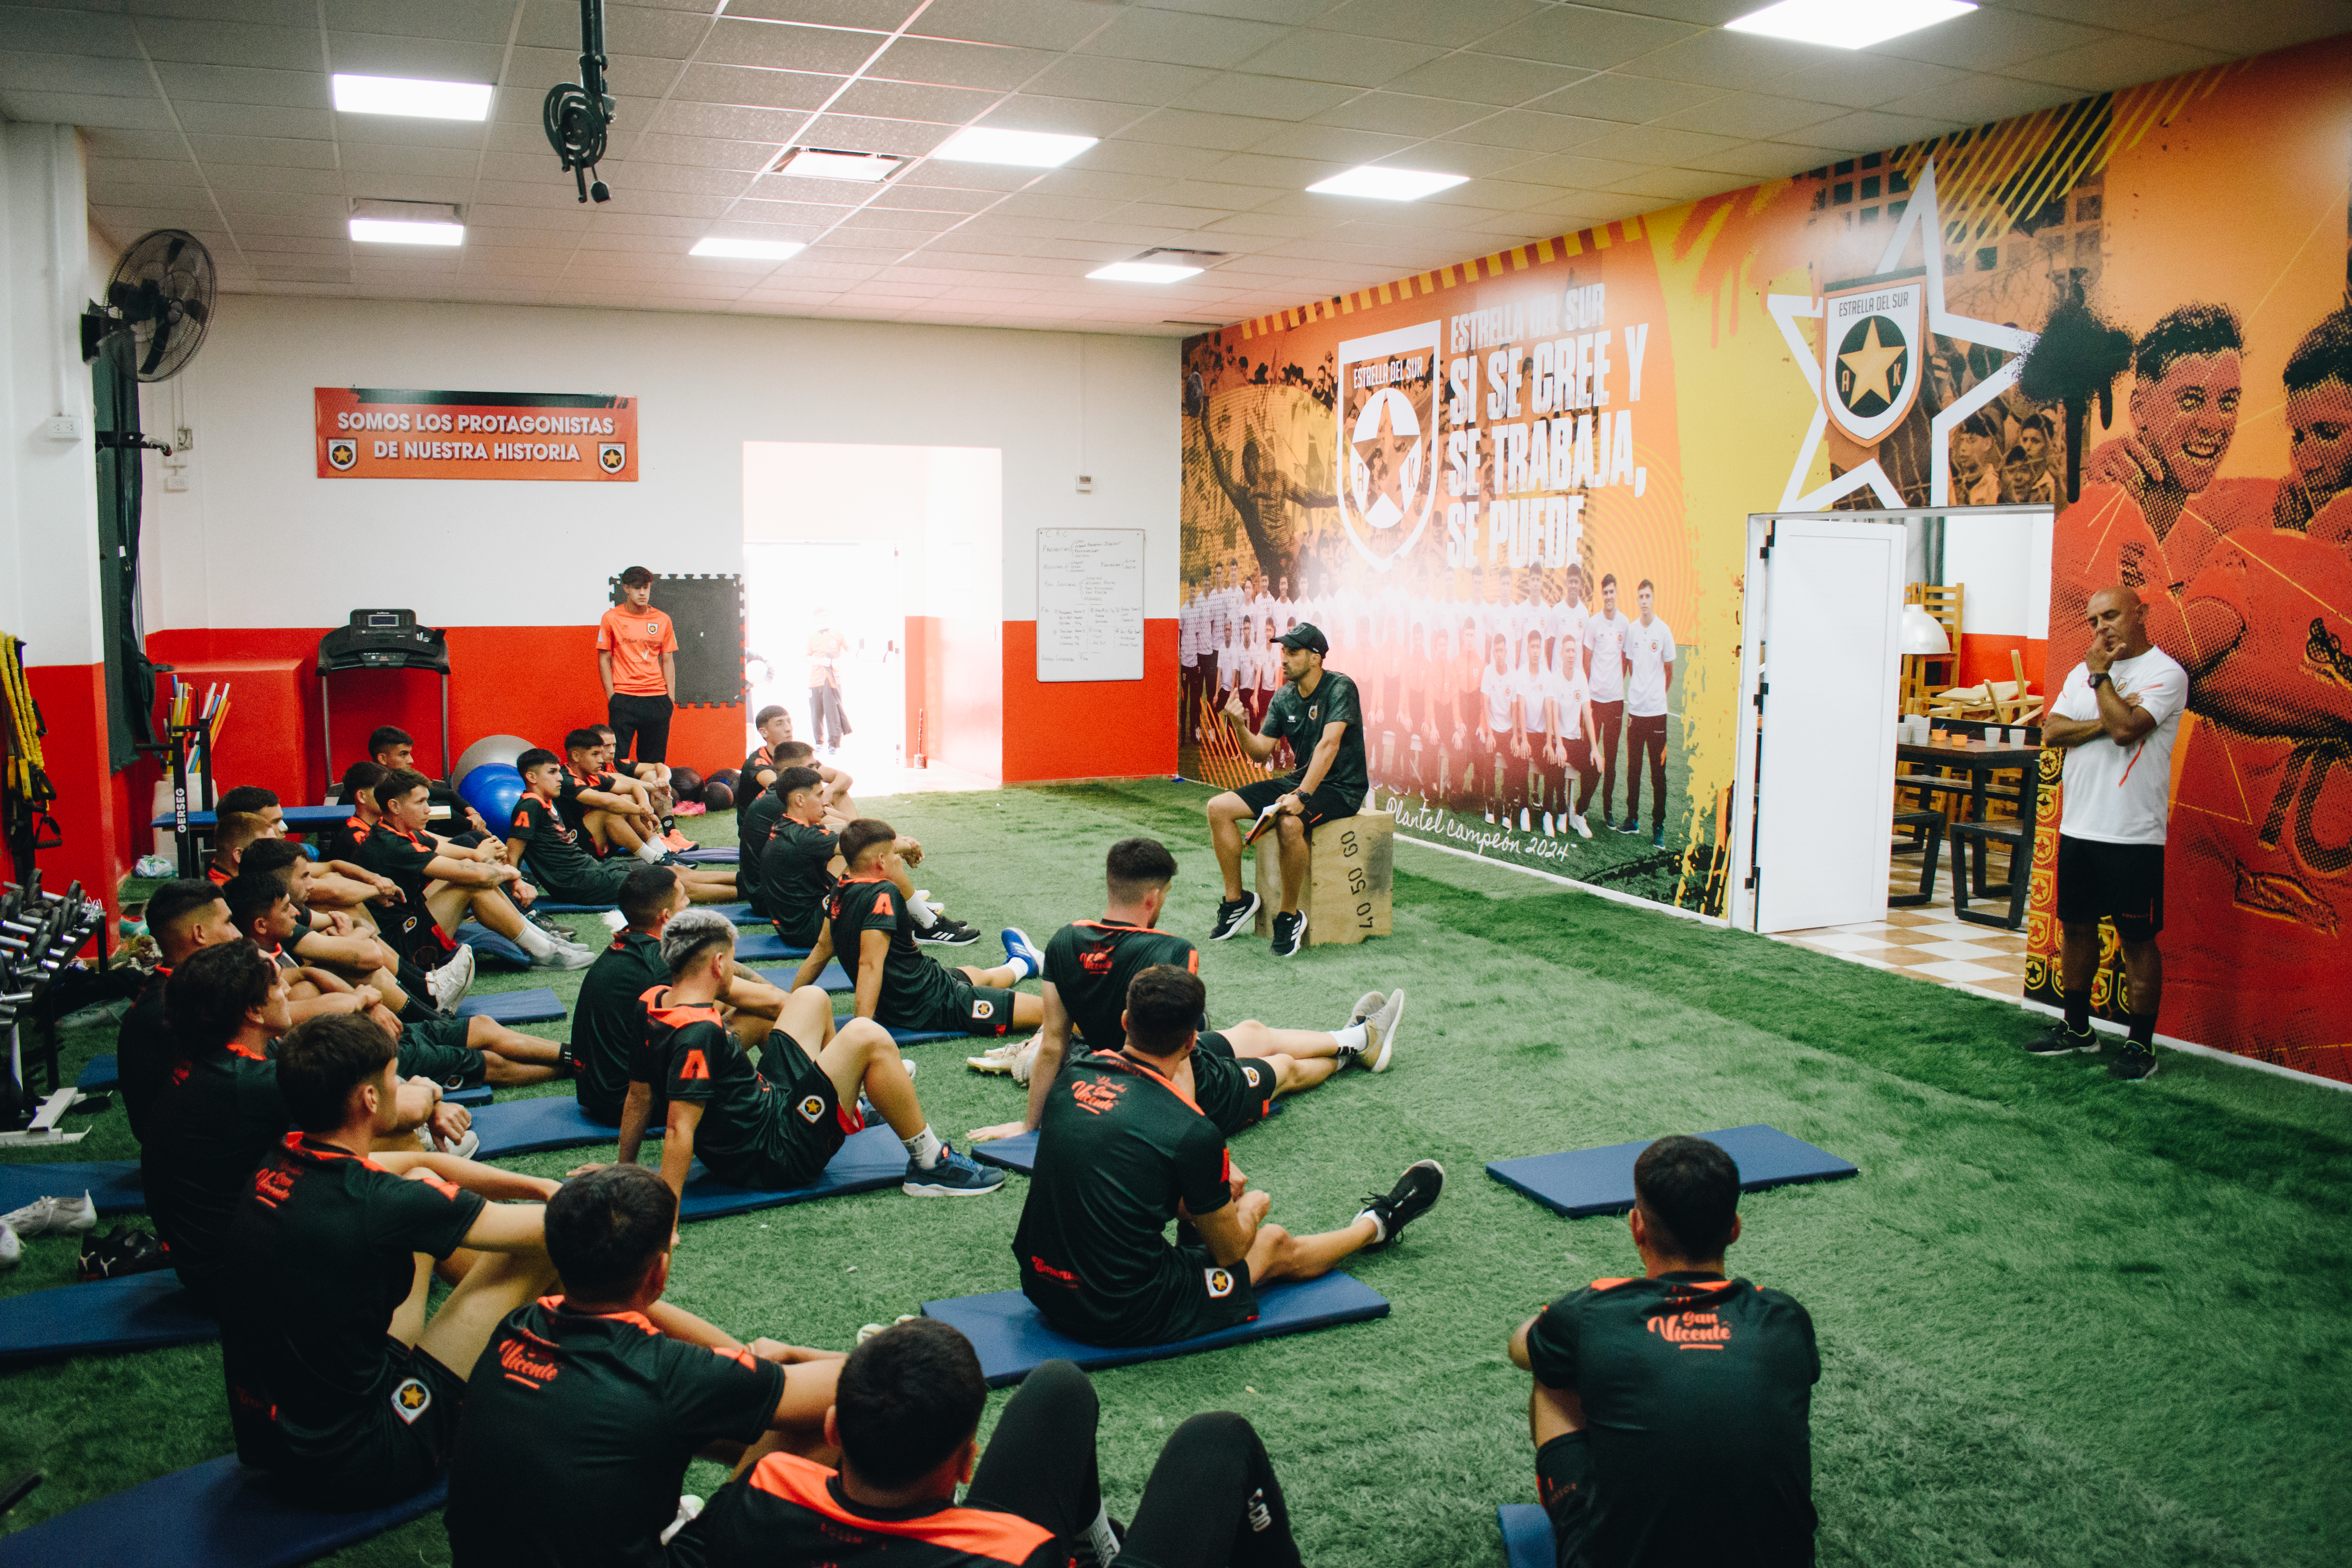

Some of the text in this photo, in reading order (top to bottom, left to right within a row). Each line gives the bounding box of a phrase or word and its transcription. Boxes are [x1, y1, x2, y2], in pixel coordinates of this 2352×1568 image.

[1450, 283, 1604, 354] ESTRELLA DEL SUR
[1839, 292, 1908, 317] ESTRELLA DEL SUR
[1354, 356, 1423, 389] ESTRELLA DEL SUR
[1449, 323, 1648, 424] SI SE CREE Y
[1842, 370, 1849, 392] A
[1893, 364, 1901, 386] K
[338, 413, 613, 434] SOMOS LOS PROTAGONISTAS
[374, 441, 580, 460] DE NUESTRA HISTORIA
[1448, 410, 1647, 498] SE TRABAJA,
[1357, 463, 1363, 492] A
[1408, 457, 1415, 488] K
[1447, 495, 1584, 569] SE PUEDE
[176, 788, 187, 833] GERSEG
[1386, 797, 1445, 834] Plantel
[1341, 831, 1358, 857] 60
[1348, 868, 1366, 895] 50
[1647, 1315, 1731, 1342] Vicente
[498, 1338, 558, 1381] Vicente
